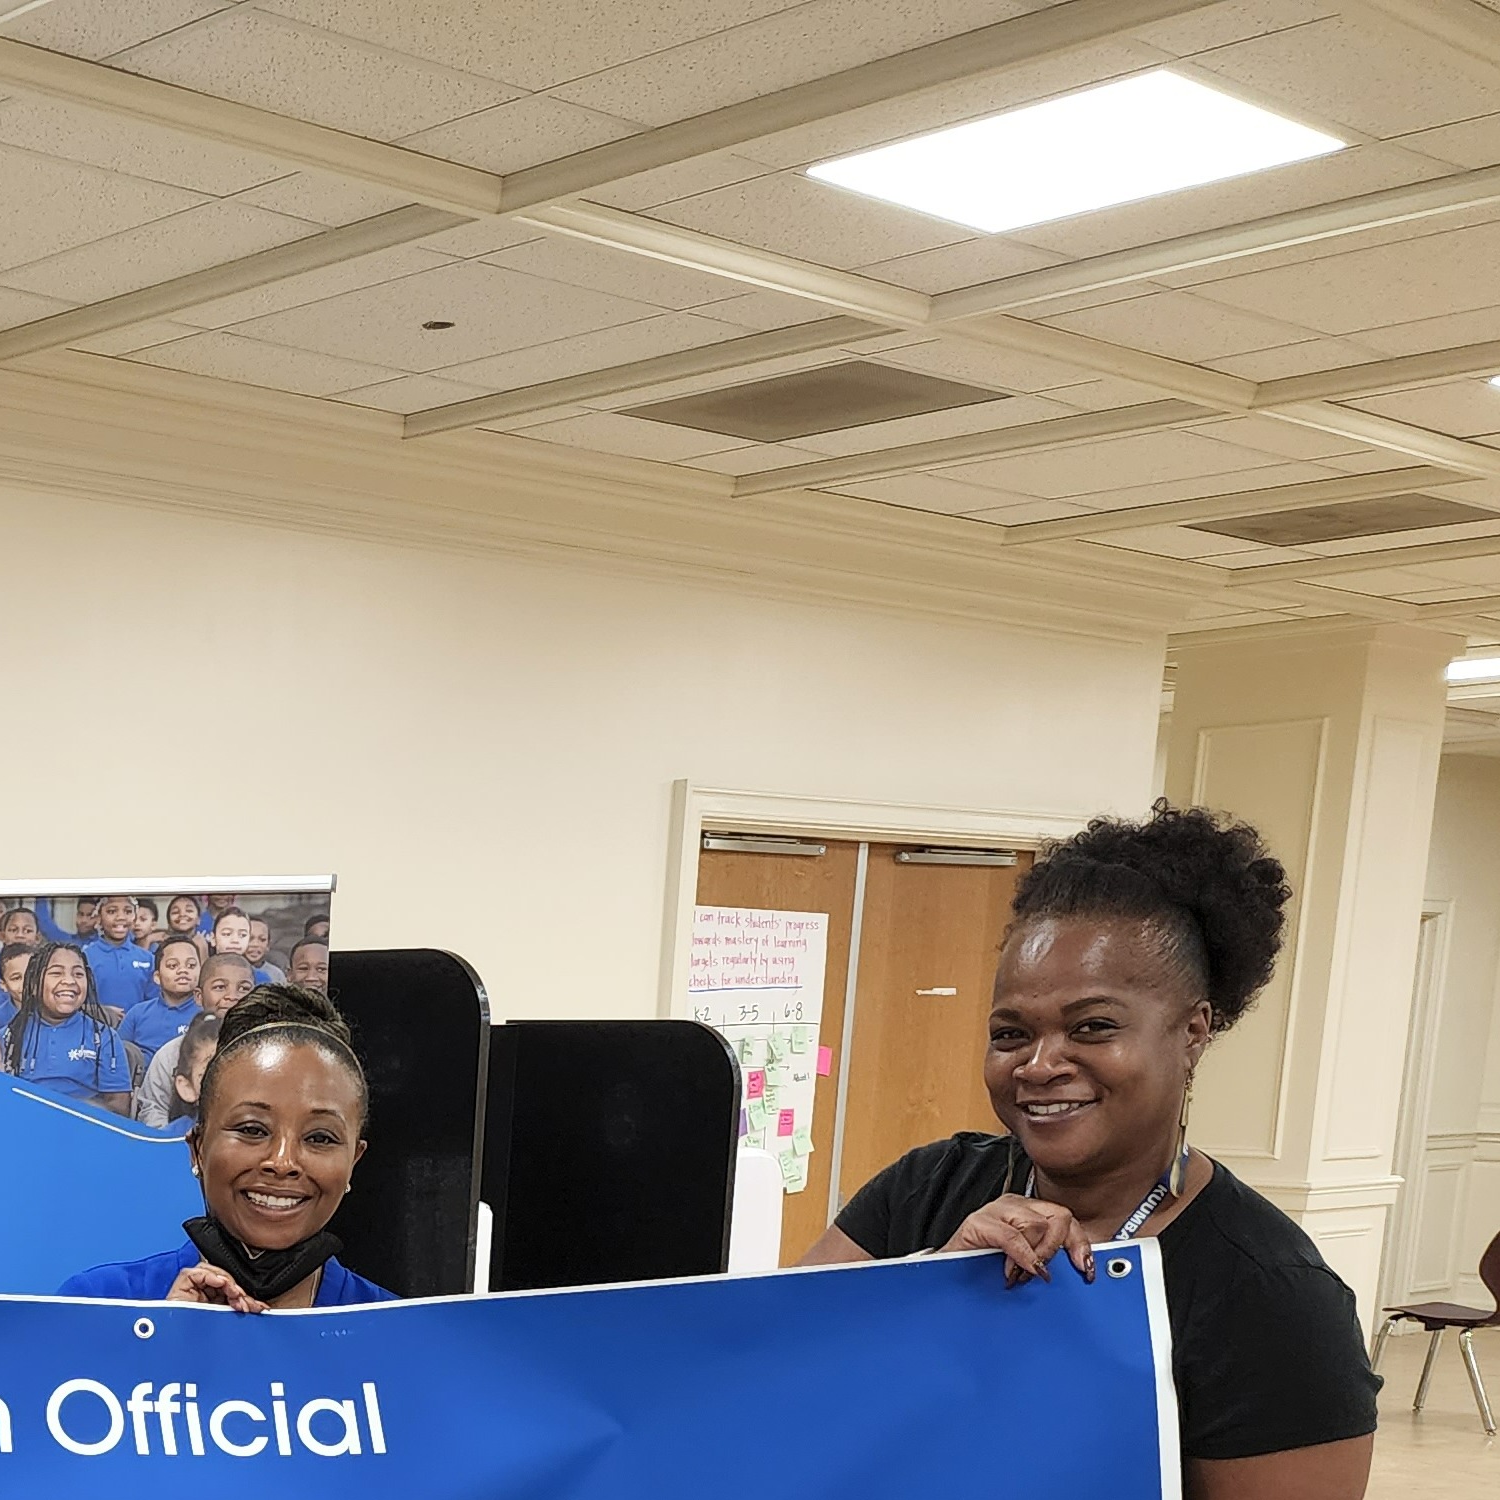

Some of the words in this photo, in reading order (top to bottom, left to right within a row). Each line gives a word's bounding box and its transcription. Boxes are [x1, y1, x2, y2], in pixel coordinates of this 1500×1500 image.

[693, 910, 697, 923] I
[700, 913, 713, 922] can
[717, 911, 741, 928] track
[785, 920, 819, 937] progress
[725, 930, 759, 954] mastery
[762, 935, 769, 946] of
[774, 936, 807, 952] learning
[760, 953, 768, 974] by
[772, 956, 795, 973] using
[722, 972, 731, 988] for
[735, 971, 799, 990] understanding
[694, 1006, 711, 1021] K-2
[784, 1001, 803, 1021] 6-8
[1115, 1184, 1168, 1240] KUUMBA
[47, 1379, 386, 1456] Official
